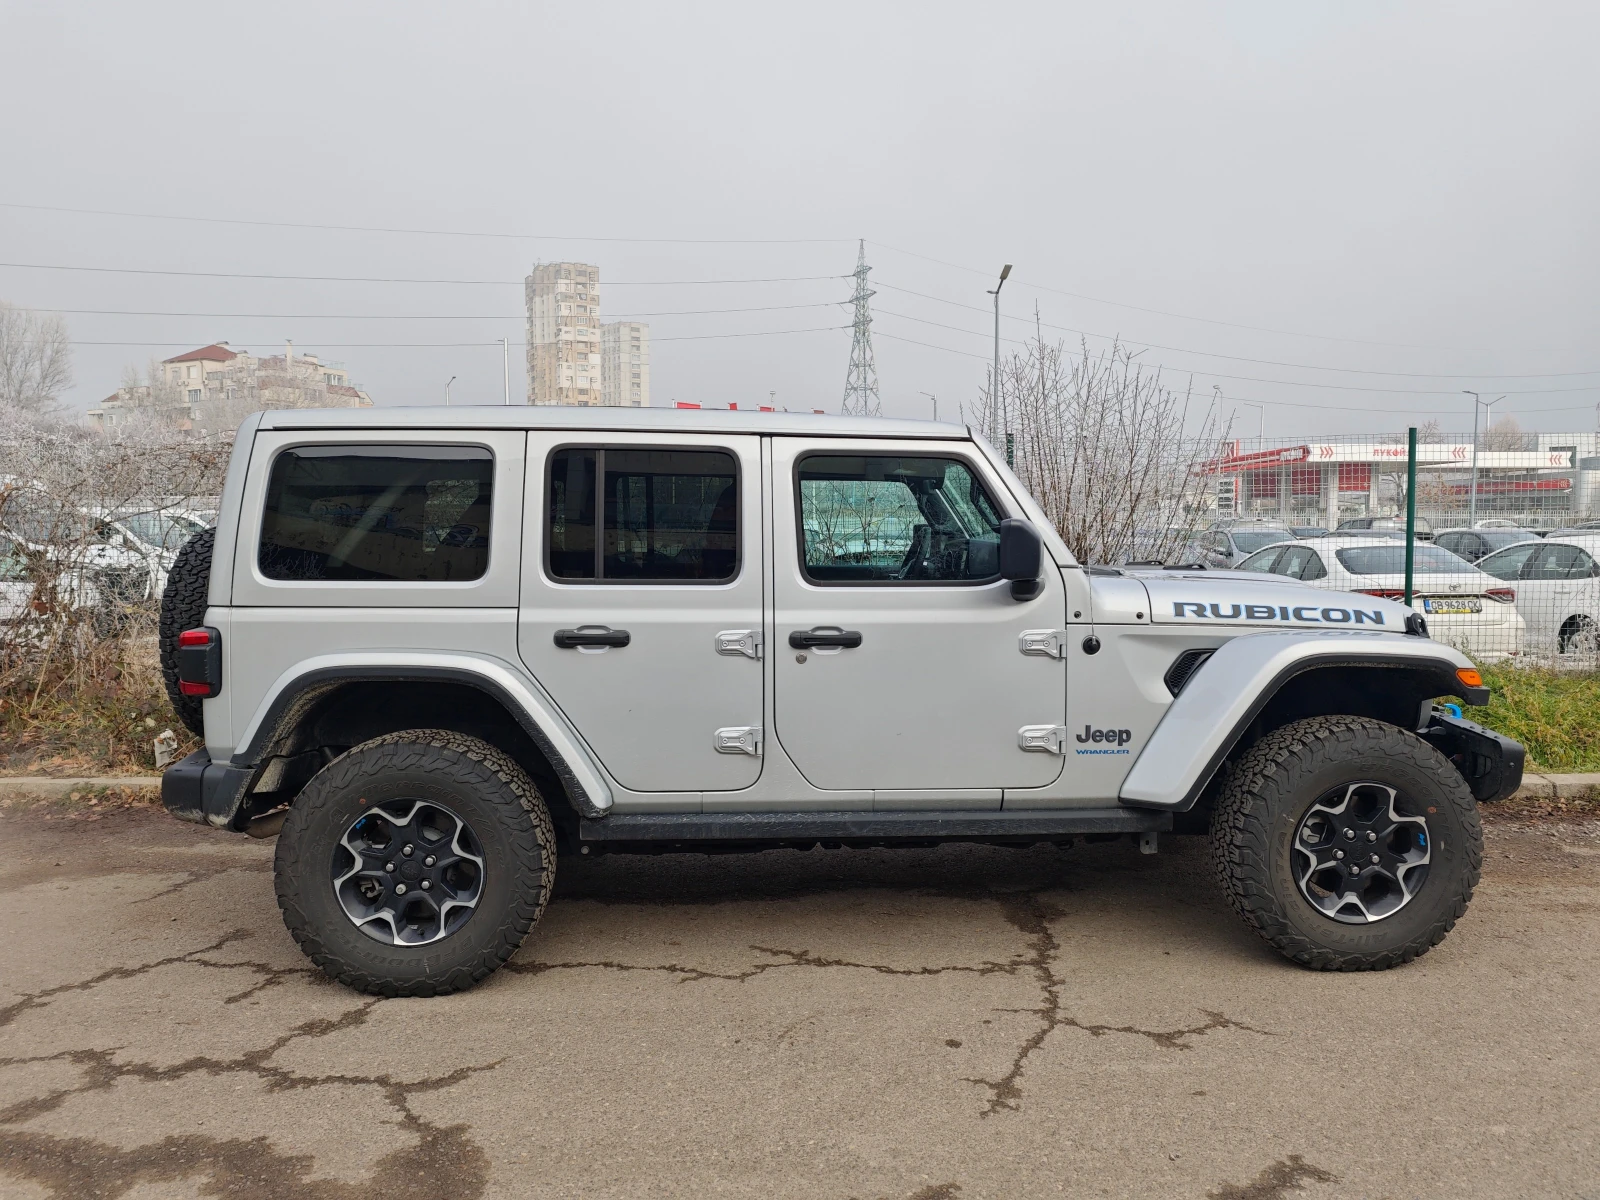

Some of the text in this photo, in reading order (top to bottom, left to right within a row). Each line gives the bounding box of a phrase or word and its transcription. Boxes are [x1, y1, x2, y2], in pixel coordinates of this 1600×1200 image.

[1373, 447, 1409, 457] ЛУКОЙ
[1431, 601, 1443, 610] CB
[1445, 601, 1466, 610] 9628
[1173, 602, 1385, 625] RUBICON
[1076, 725, 1131, 746] Jeep
